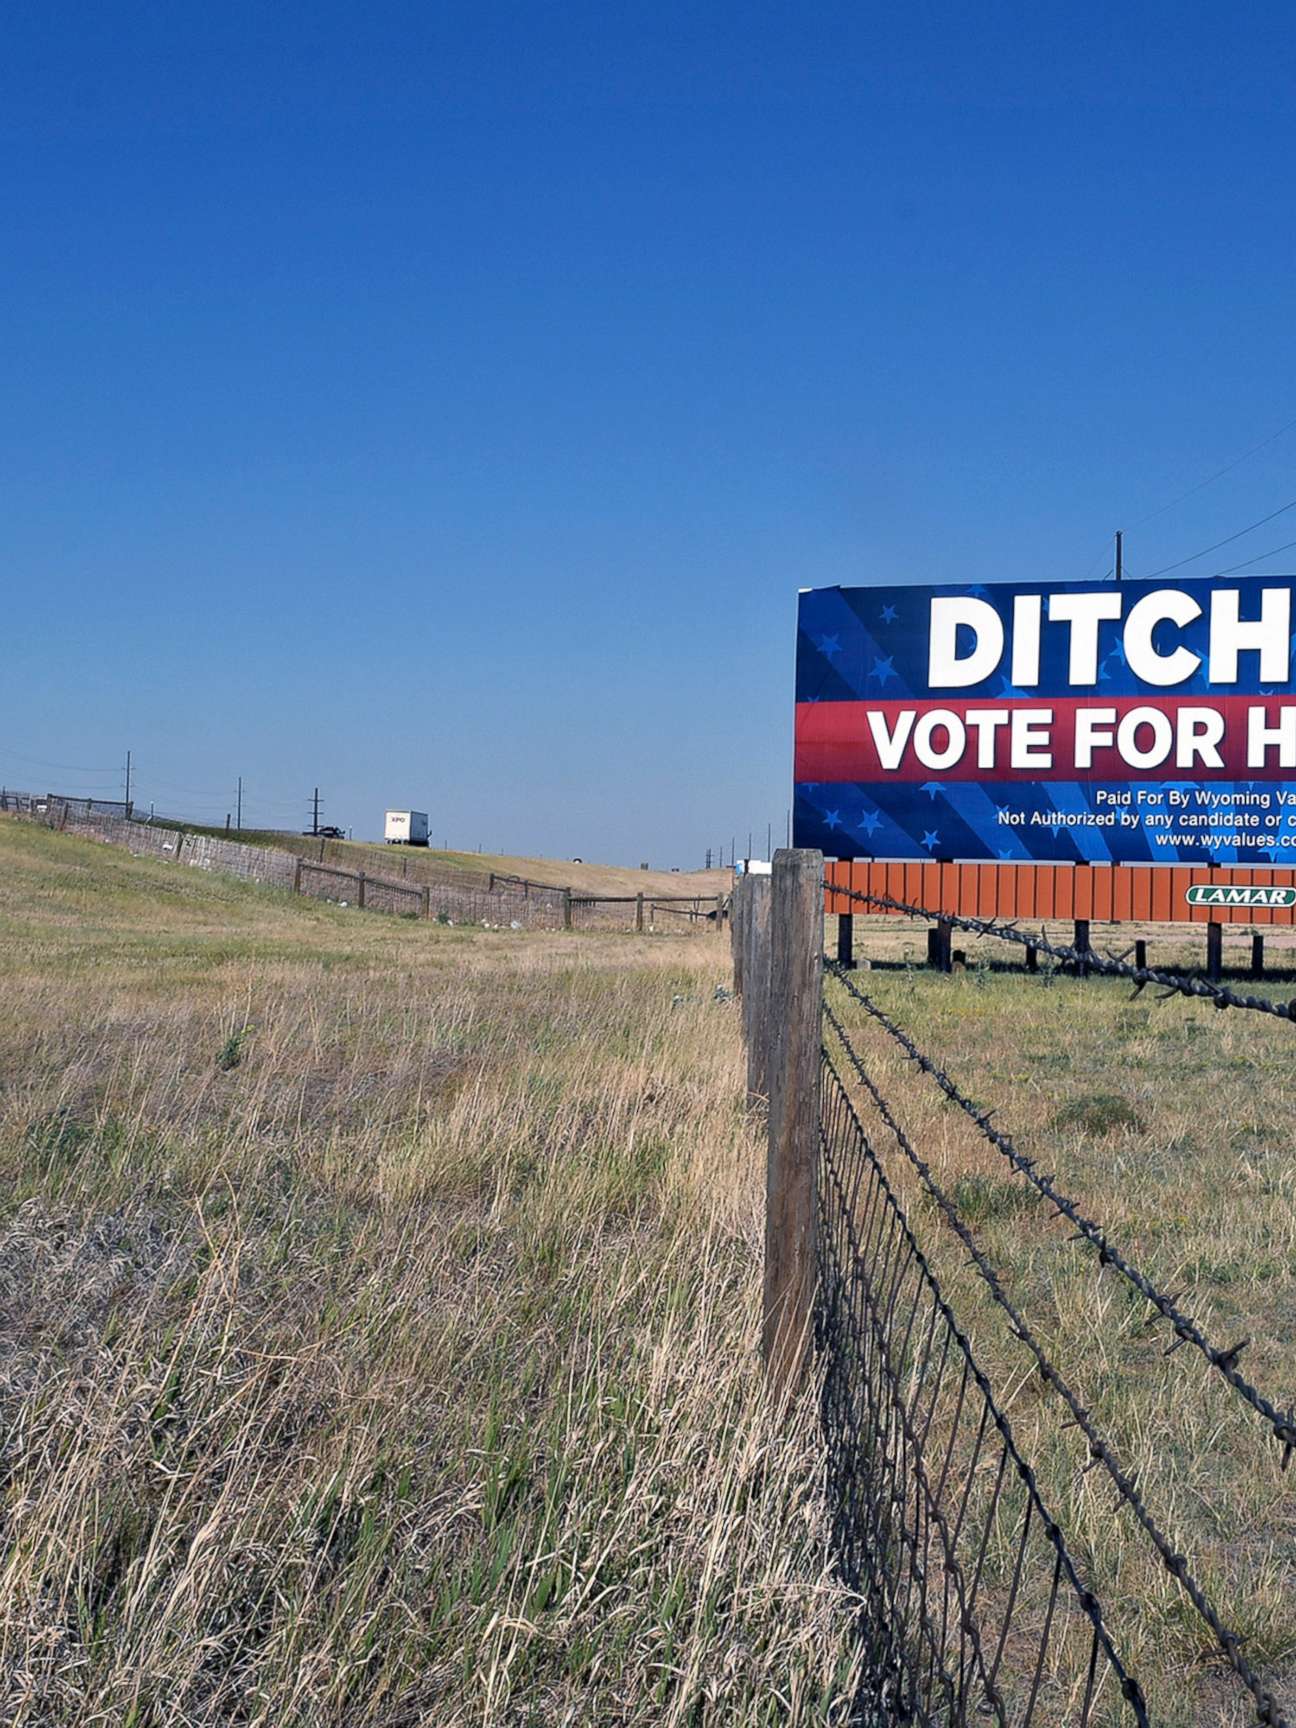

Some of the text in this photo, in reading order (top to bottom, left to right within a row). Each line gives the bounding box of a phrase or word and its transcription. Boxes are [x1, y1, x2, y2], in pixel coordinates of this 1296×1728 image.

[928, 588, 1290, 687] DITCH
[866, 707, 1053, 769] VOTE
[1074, 705, 1225, 769] FOR
[1096, 791, 1131, 805] Paid
[1137, 791, 1164, 805] For
[1169, 791, 1190, 809] By
[1195, 791, 1271, 808] Wyoming
[998, 812, 1025, 825] Not
[1030, 811, 1115, 826] Authorized
[1120, 811, 1140, 829] by
[1145, 815, 1174, 829] any
[1179, 812, 1260, 826] candidate
[1265, 816, 1283, 826] or
[1194, 888, 1287, 903] LAMAR
